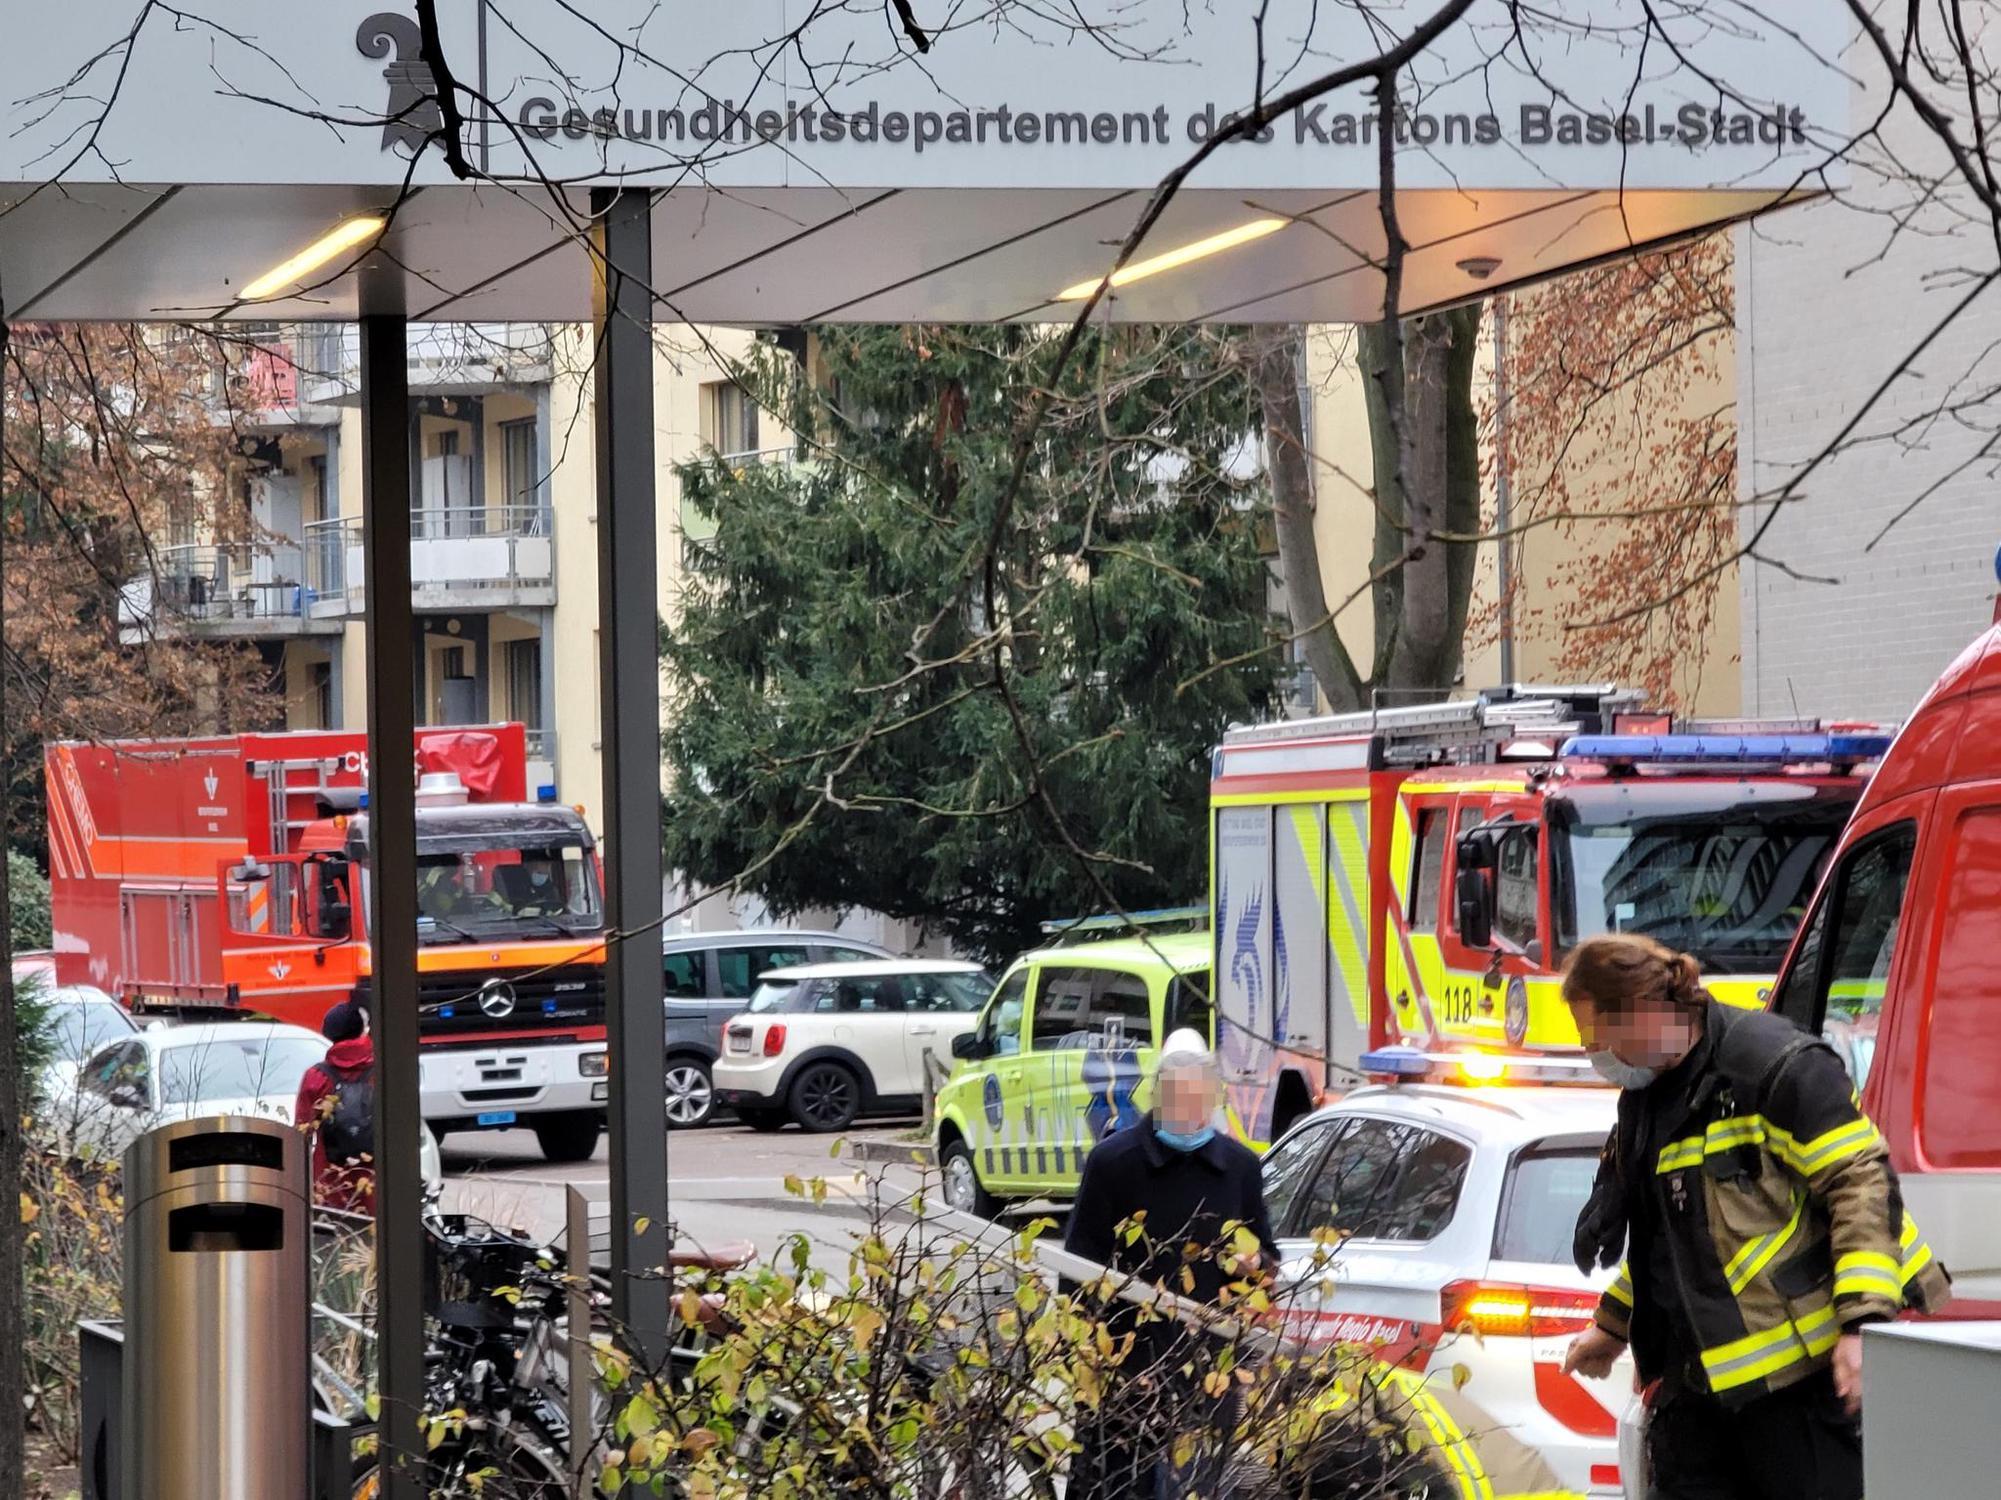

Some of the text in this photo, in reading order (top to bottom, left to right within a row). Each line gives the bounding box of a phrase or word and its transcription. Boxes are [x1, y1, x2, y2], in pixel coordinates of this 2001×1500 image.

[519, 97, 1169, 153] Gesundheitsdepartement
[1520, 103, 1805, 146] Basel-Stadt
[1445, 986, 1471, 1023] 118
